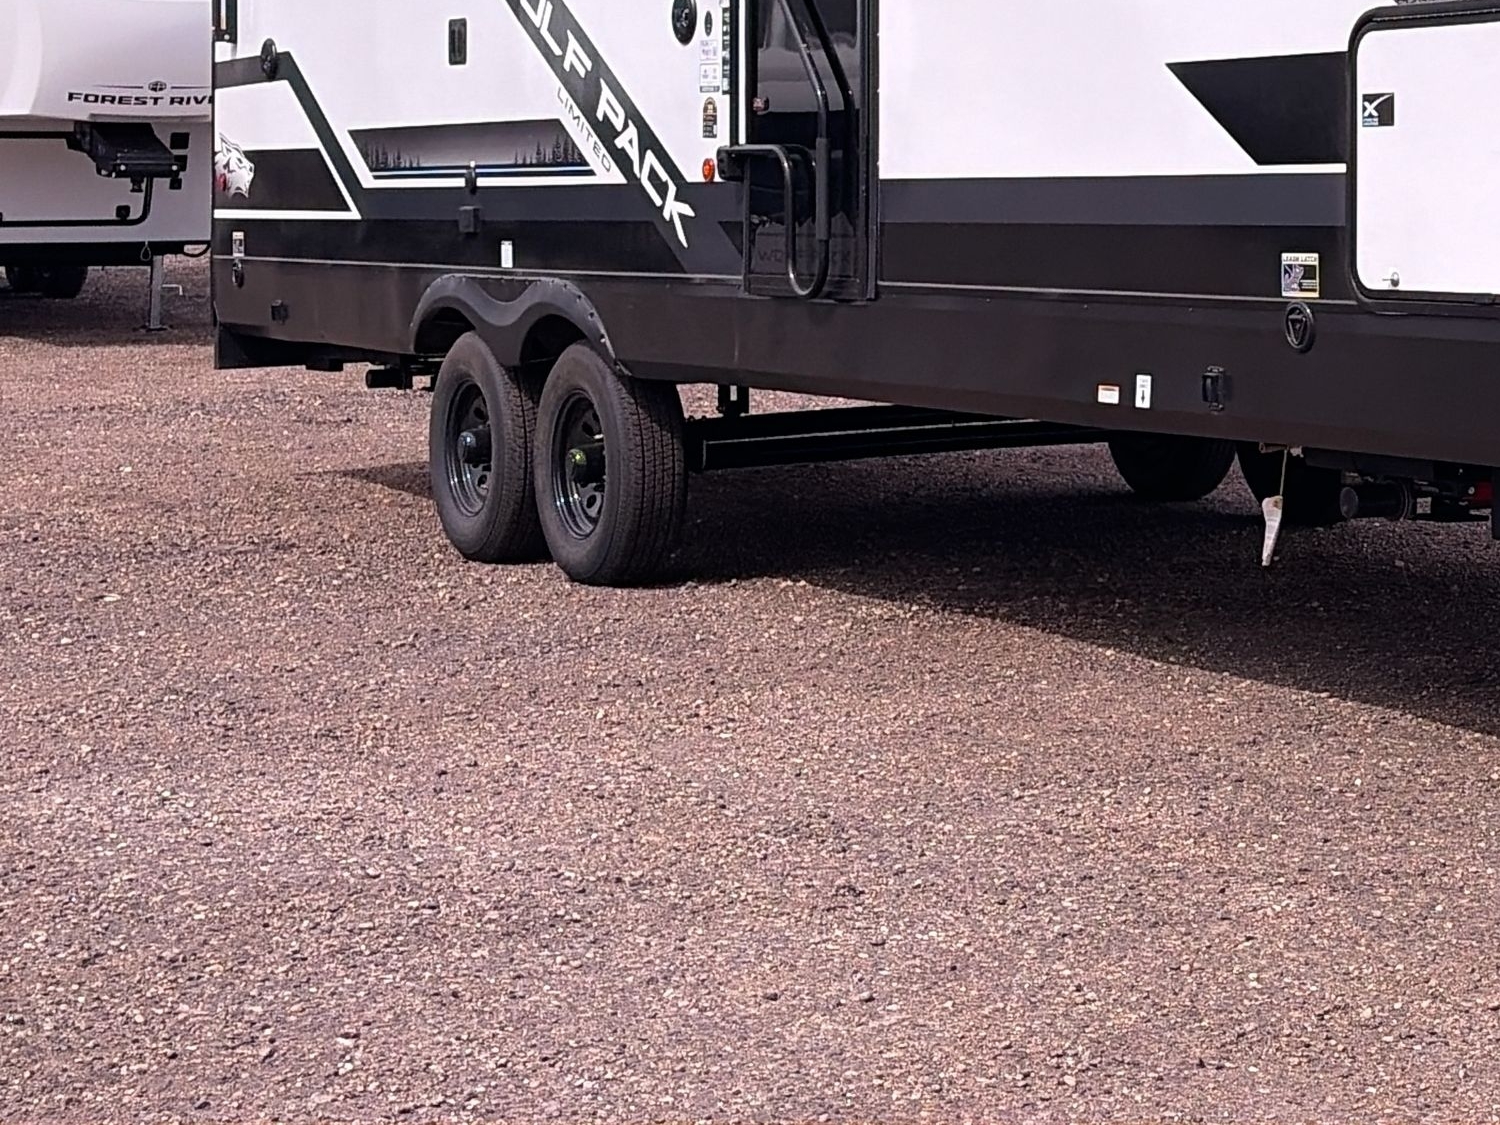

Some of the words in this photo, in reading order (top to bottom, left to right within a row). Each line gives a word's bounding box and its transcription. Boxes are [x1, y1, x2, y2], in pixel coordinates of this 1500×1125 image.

[67, 91, 164, 106] FOREST
[169, 95, 212, 106] RIV
[556, 86, 612, 173] LIMITED
[595, 77, 696, 249] PACK
